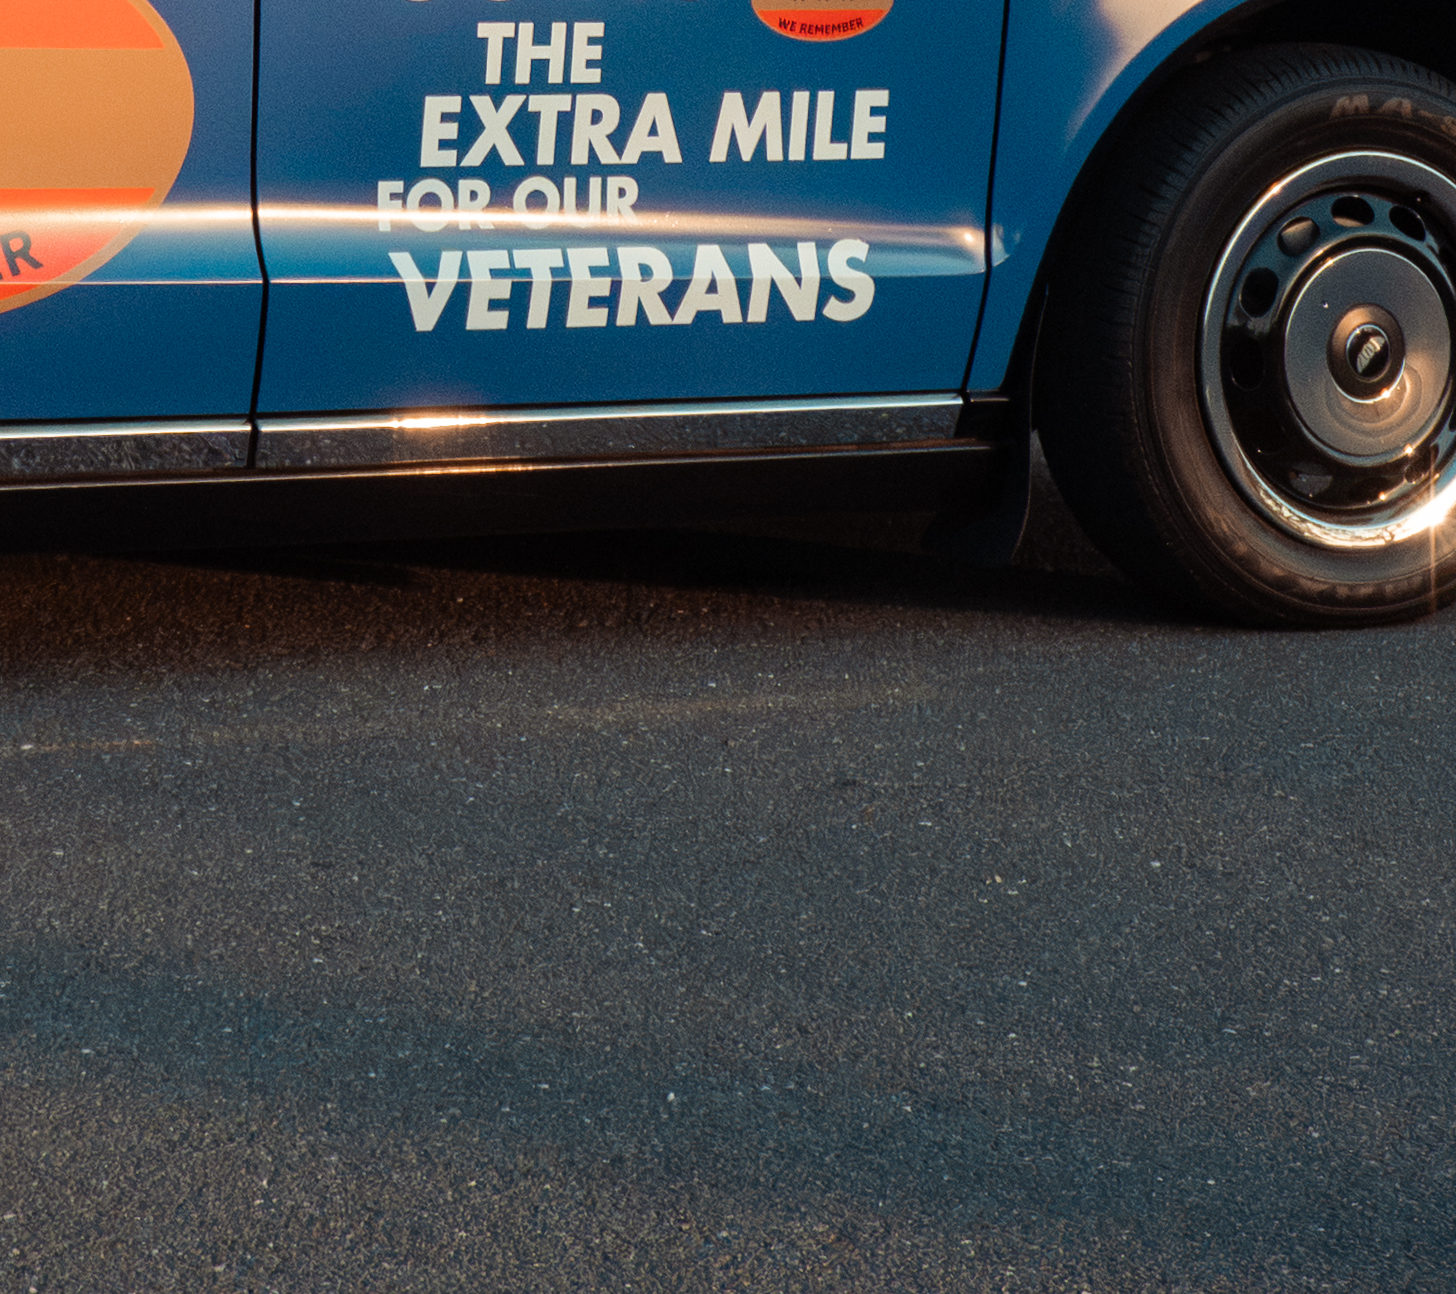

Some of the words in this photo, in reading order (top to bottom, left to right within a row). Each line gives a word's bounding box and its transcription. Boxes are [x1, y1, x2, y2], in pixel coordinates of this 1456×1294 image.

[477, 21, 605, 85] THE
[778, 17, 796, 32] WE
[800, 17, 864, 35] REMEMBER
[420, 94, 683, 167] EXTRA
[709, 89, 889, 163] MILE
[377, 178, 495, 232] FOR
[512, 176, 641, 229] OUR
[388, 239, 876, 332] VETERANS
